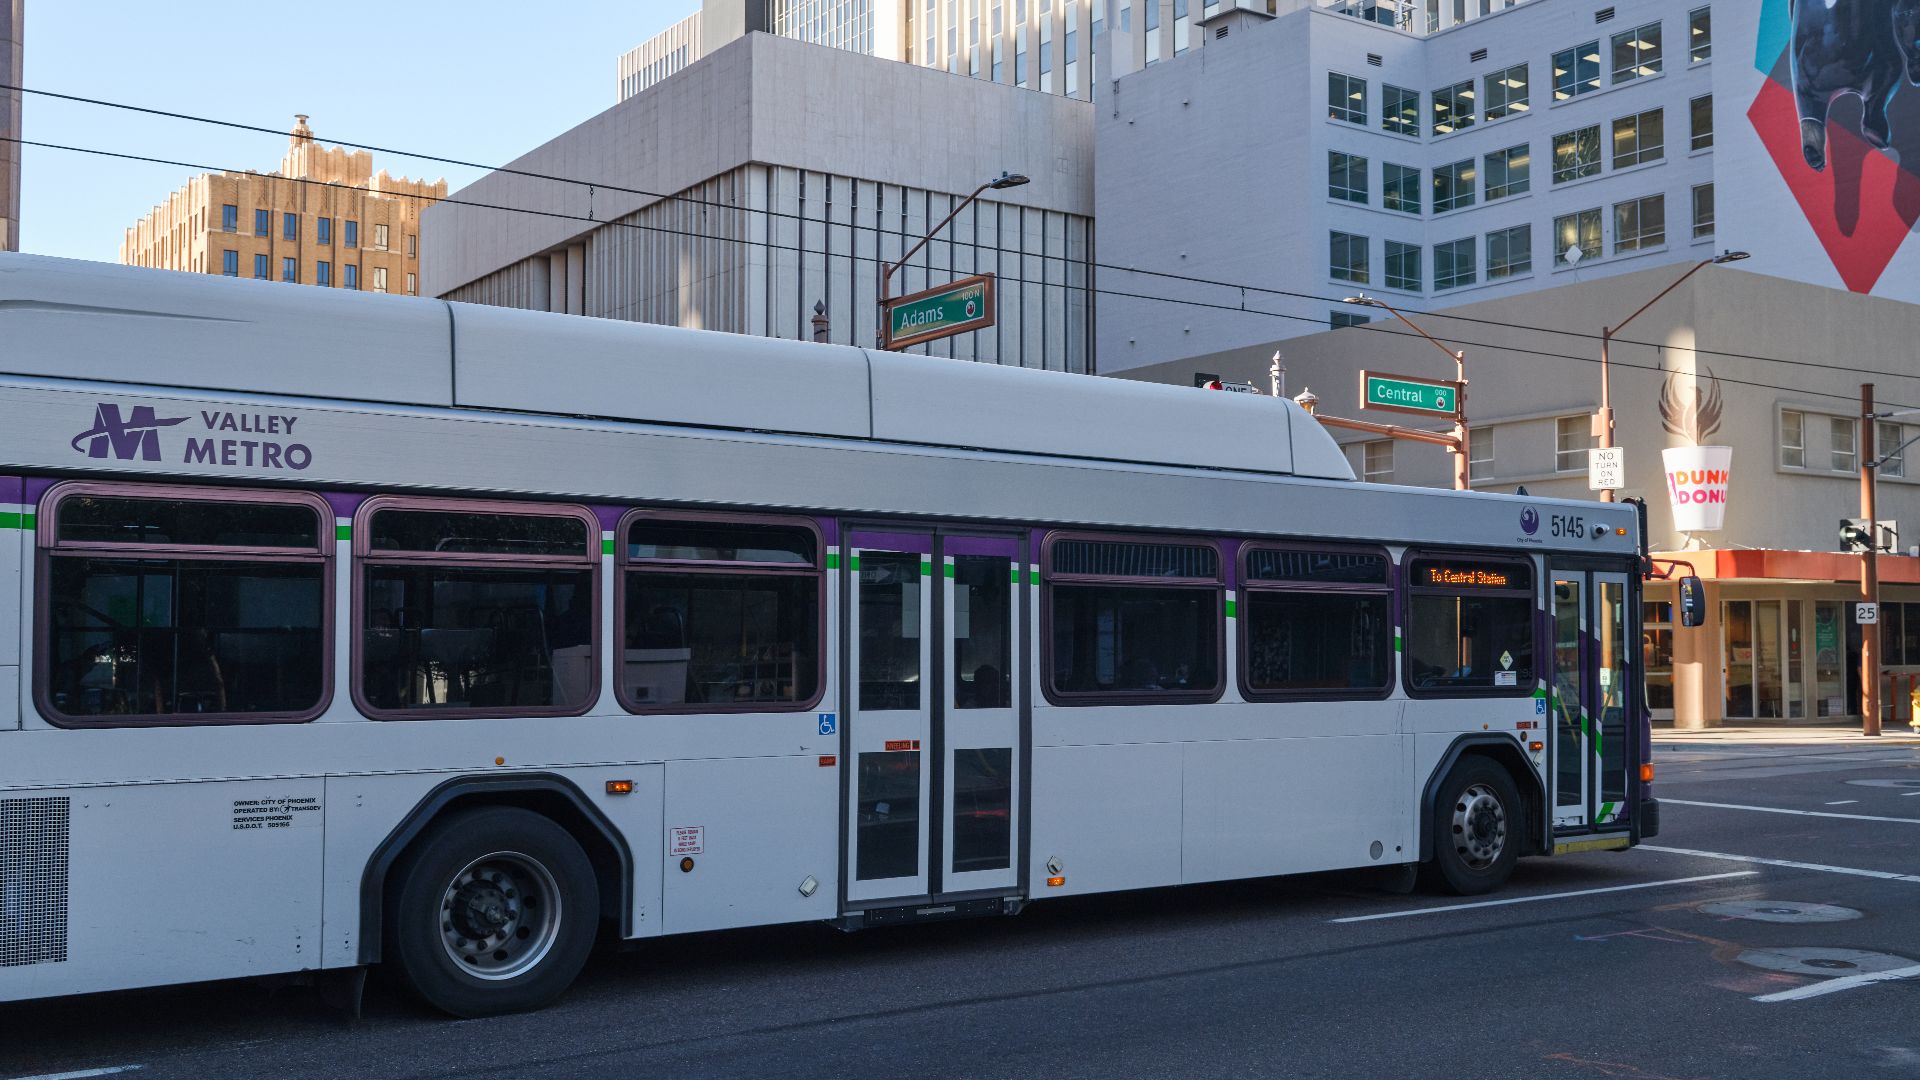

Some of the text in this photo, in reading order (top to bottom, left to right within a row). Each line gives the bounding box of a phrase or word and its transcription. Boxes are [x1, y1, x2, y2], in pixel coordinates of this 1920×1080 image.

[961, 289, 980, 301] 100 N
[901, 306, 944, 330] Adams
[1377, 385, 1423, 403] Central
[201, 410, 298, 435] VALLEY
[183, 437, 313, 471] METRO
[1598, 452, 1614, 460] NO
[1675, 469, 1728, 486] DUNK
[1551, 514, 1584, 538] 5145
[1430, 569, 1506, 585] To Central Station
[1858, 607, 1875, 619] 25
